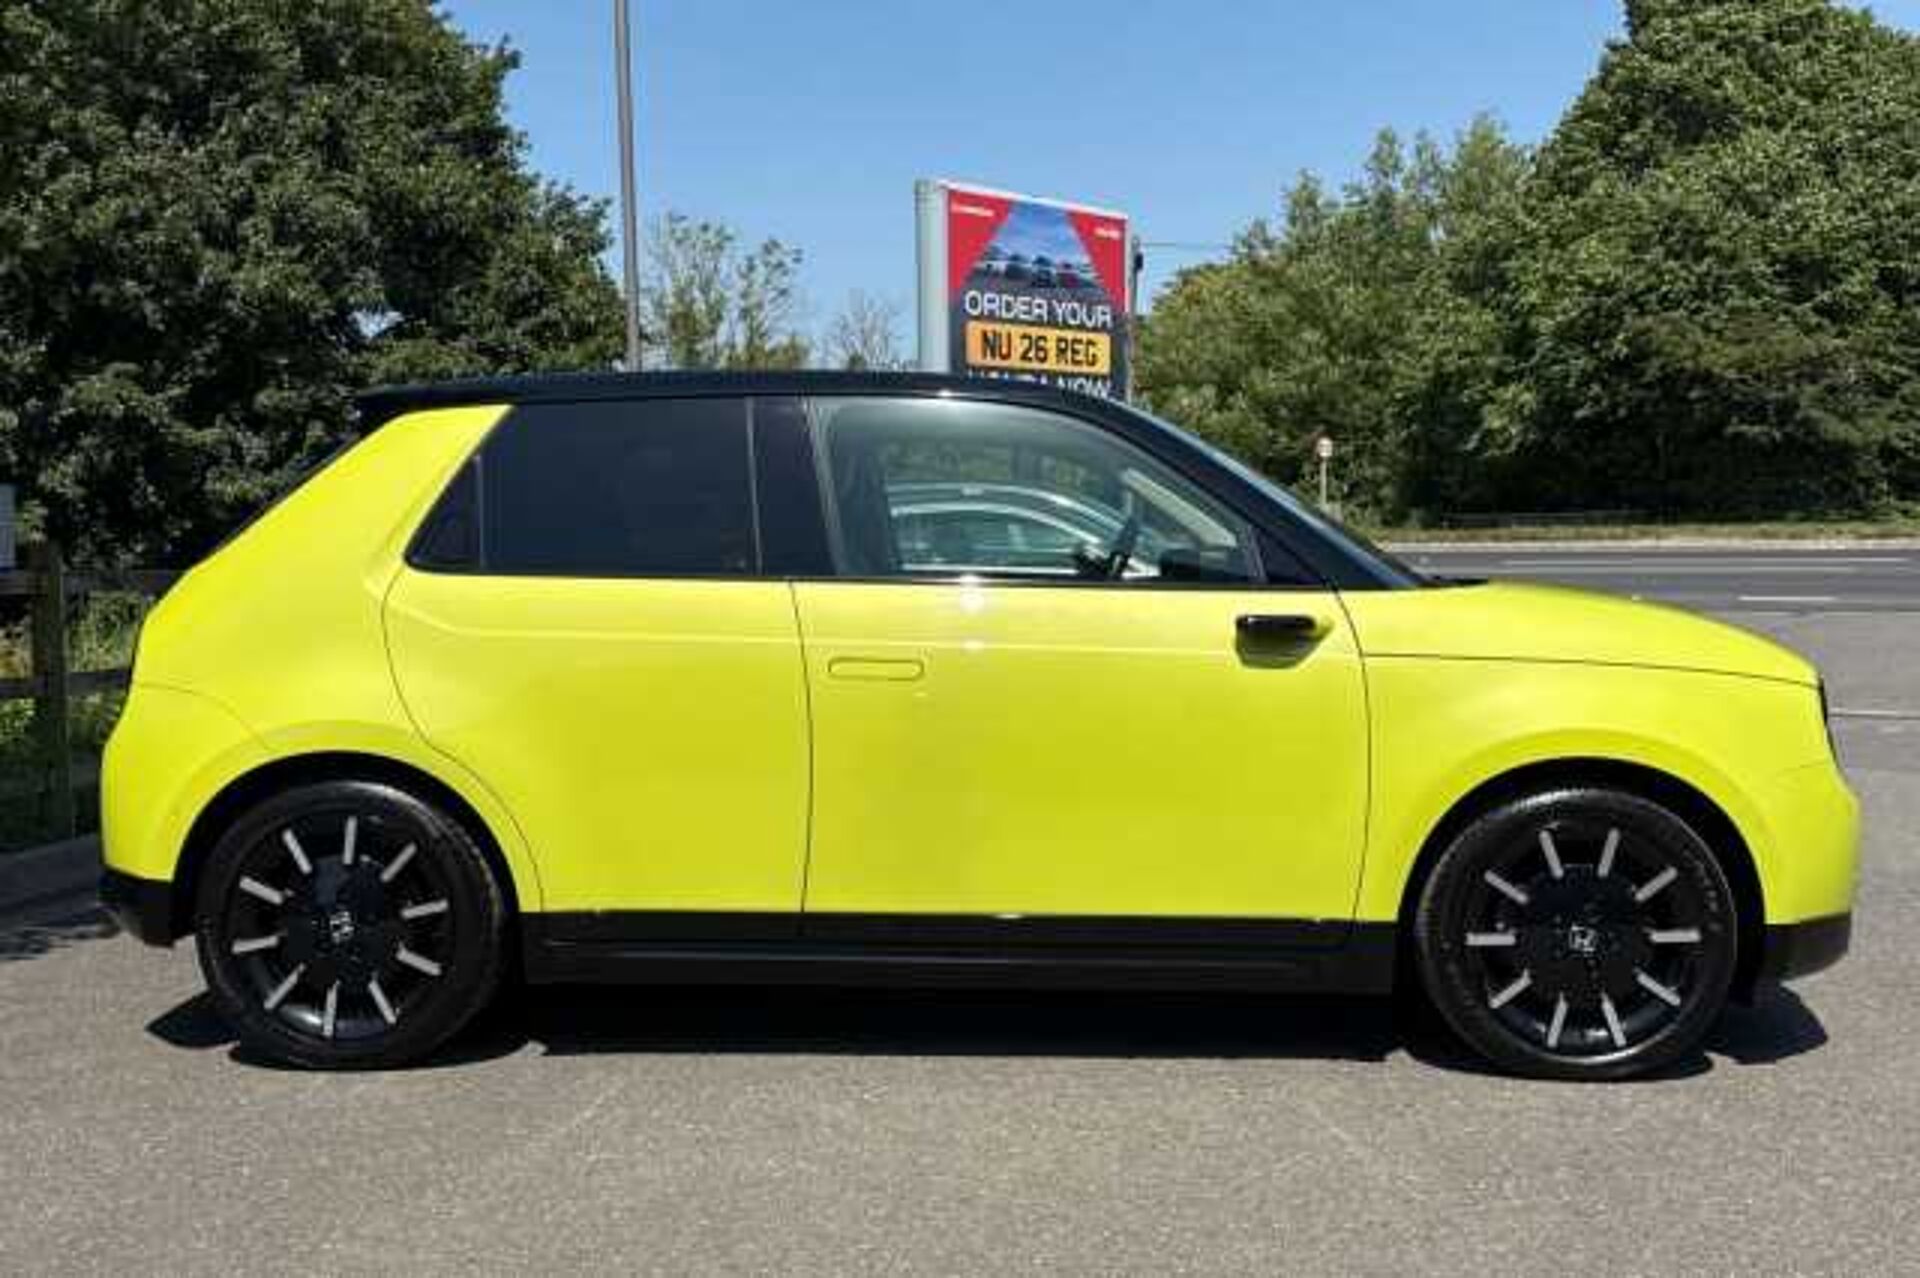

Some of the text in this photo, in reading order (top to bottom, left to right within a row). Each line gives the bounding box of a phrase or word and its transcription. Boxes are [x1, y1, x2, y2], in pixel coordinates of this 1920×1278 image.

[965, 290, 1113, 328] ORDER YOUR
[981, 329, 1098, 367] NU 26 REG
